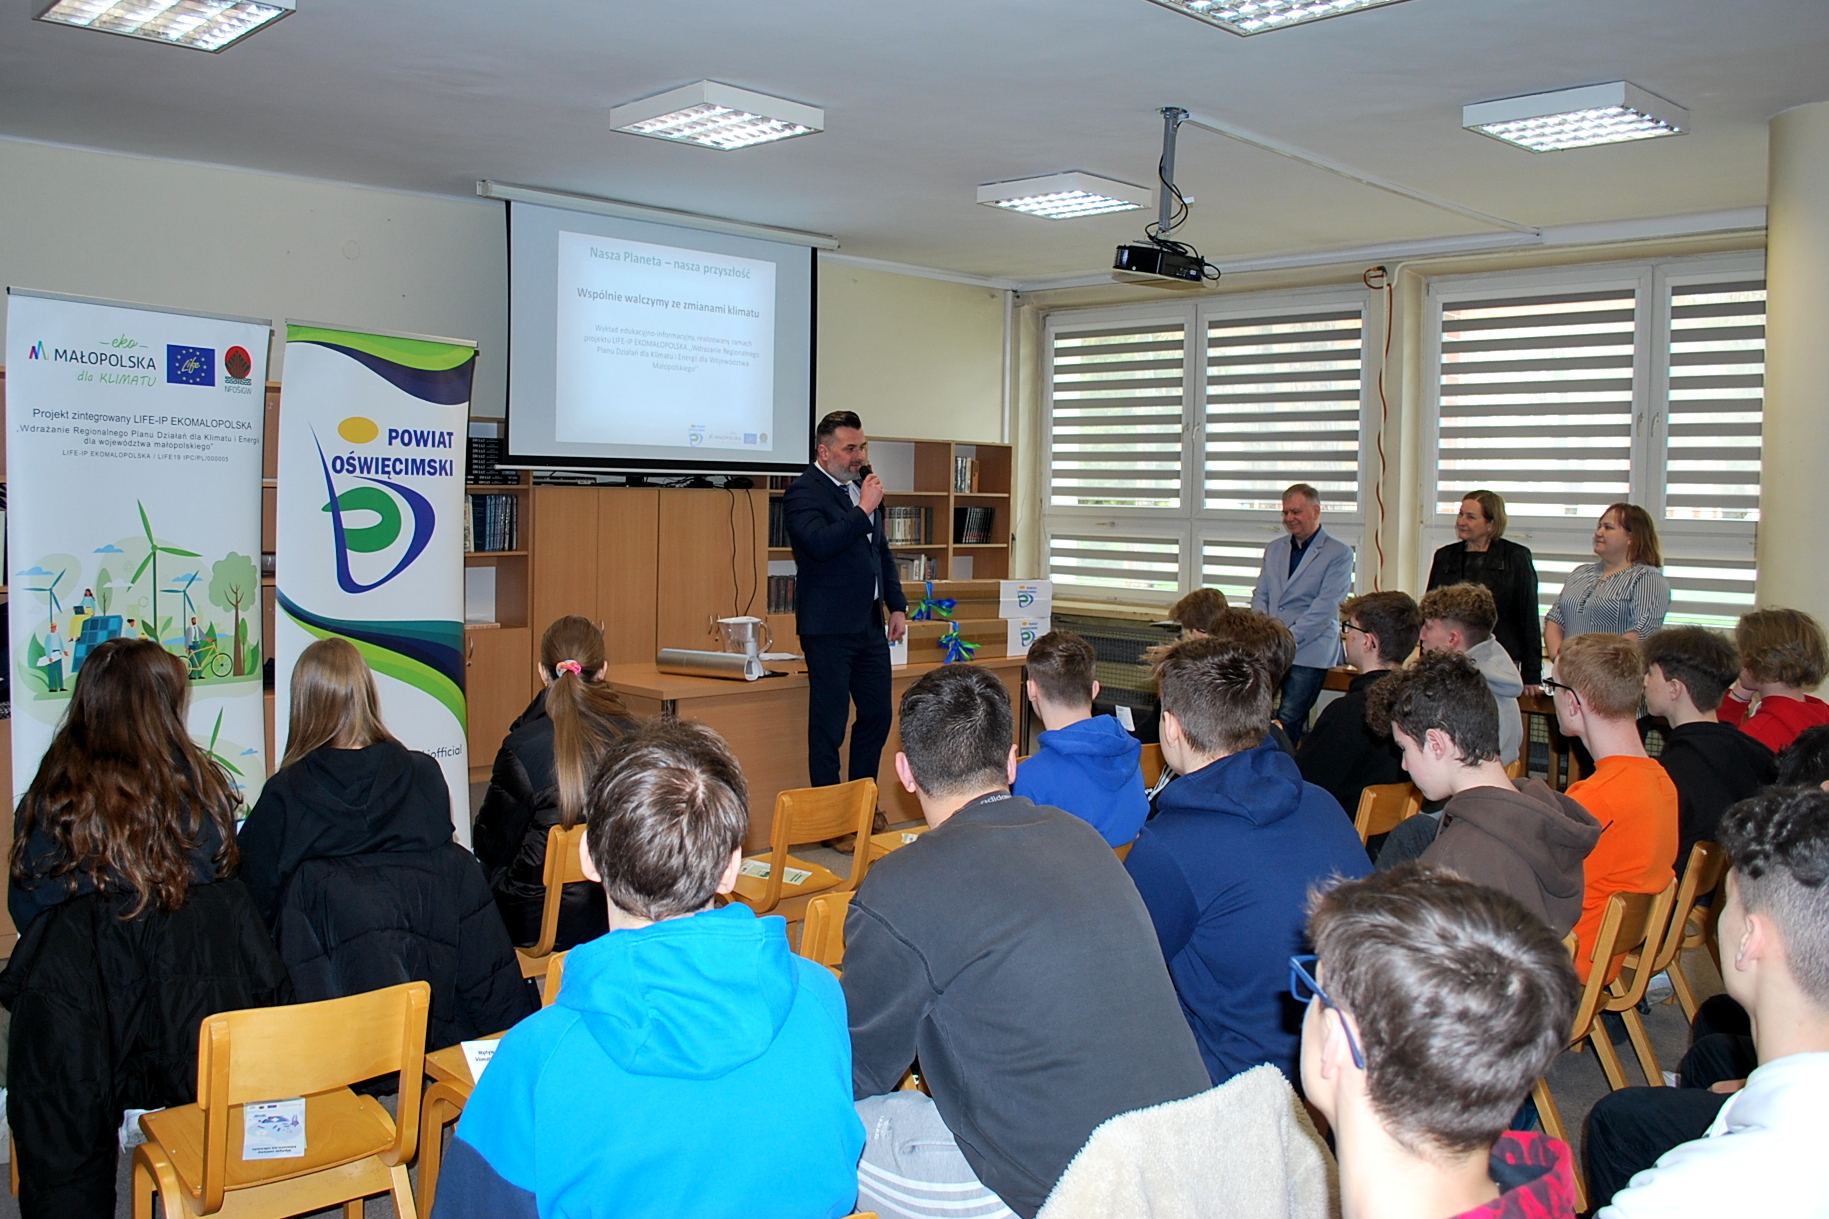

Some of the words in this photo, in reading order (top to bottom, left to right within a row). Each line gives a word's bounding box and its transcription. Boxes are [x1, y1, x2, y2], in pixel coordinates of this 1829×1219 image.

[590, 247, 620, 261] Nasza
[624, 251, 662, 267] Planeta
[673, 261, 700, 272] nasza
[703, 264, 751, 279] przyszłość
[577, 287, 623, 302] Wspólnie
[624, 294, 670, 309] walczymy
[671, 300, 681, 309] ze
[683, 301, 726, 314] zmianami
[727, 305, 760, 318] klimatu
[111, 333, 138, 349] eko
[54, 348, 156, 370] MAŁOPOLSKA
[77, 370, 93, 382] dla
[99, 373, 156, 387] KLIMATU
[33, 408, 69, 421] Projekt
[72, 411, 131, 425] zintegrowany
[133, 415, 168, 425] LIFE-IP
[171, 416, 252, 430] EKOMALOPOLSKA
[73, 426, 128, 438] Regionalnego
[131, 430, 154, 439] Planu
[157, 431, 187, 440] Działań
[204, 433, 232, 442] Klimatu
[238, 436, 260, 445] Energii
[99, 438, 151, 448] województwa
[388, 428, 454, 448] POWIAT
[91, 451, 151, 459] EKOMALOPOLSKA
[331, 450, 454, 479] OŚWIĘCIMSKI
